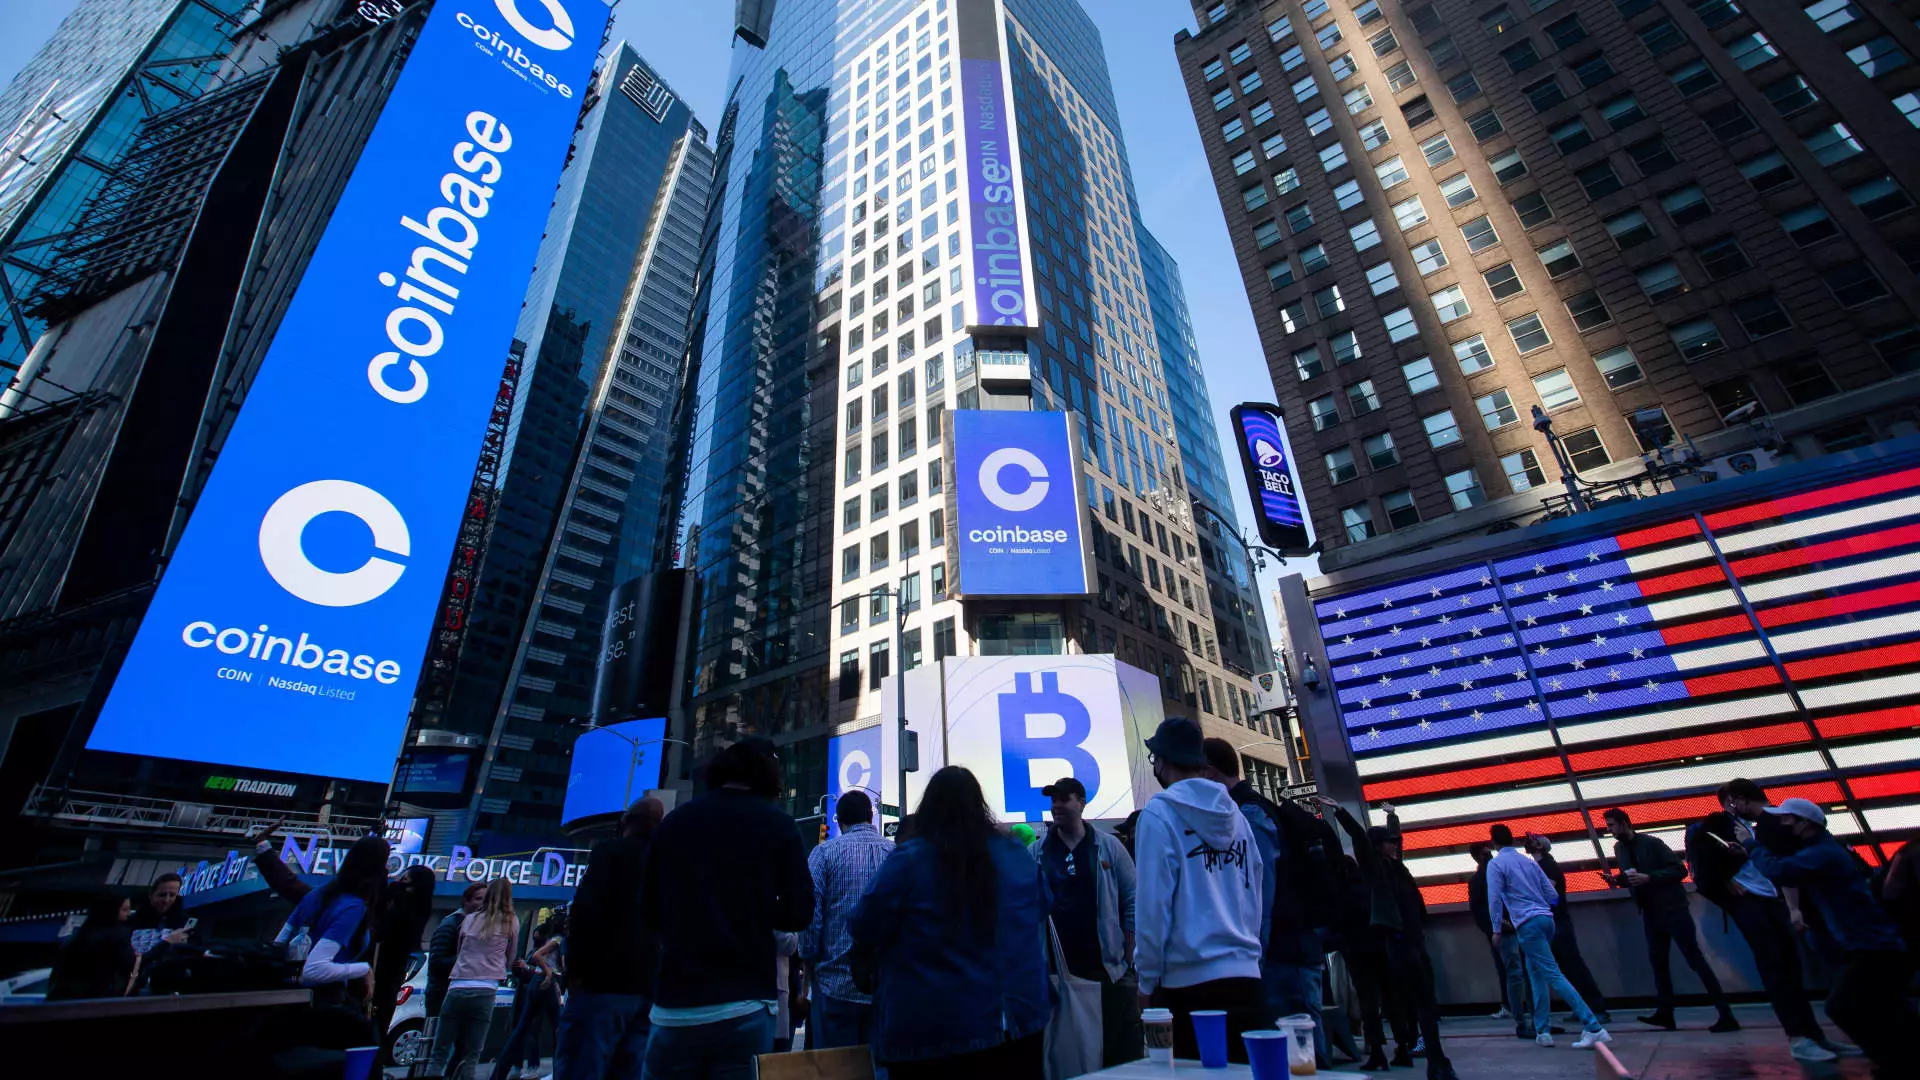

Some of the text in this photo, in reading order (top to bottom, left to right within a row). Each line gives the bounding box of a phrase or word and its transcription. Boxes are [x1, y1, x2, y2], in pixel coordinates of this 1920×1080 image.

[456, 12, 573, 98] coinbase
[368, 111, 512, 404] coinbase
[1259, 469, 1290, 485] TACO
[1264, 480, 1293, 495] BELL
[969, 525, 1068, 543] coinbase
[182, 620, 401, 684] coinbase
[217, 667, 356, 701] COIN Nasdaq Listed
[1283, 786, 1314, 798] ONE WAY
[446, 845, 533, 884] POLICE
